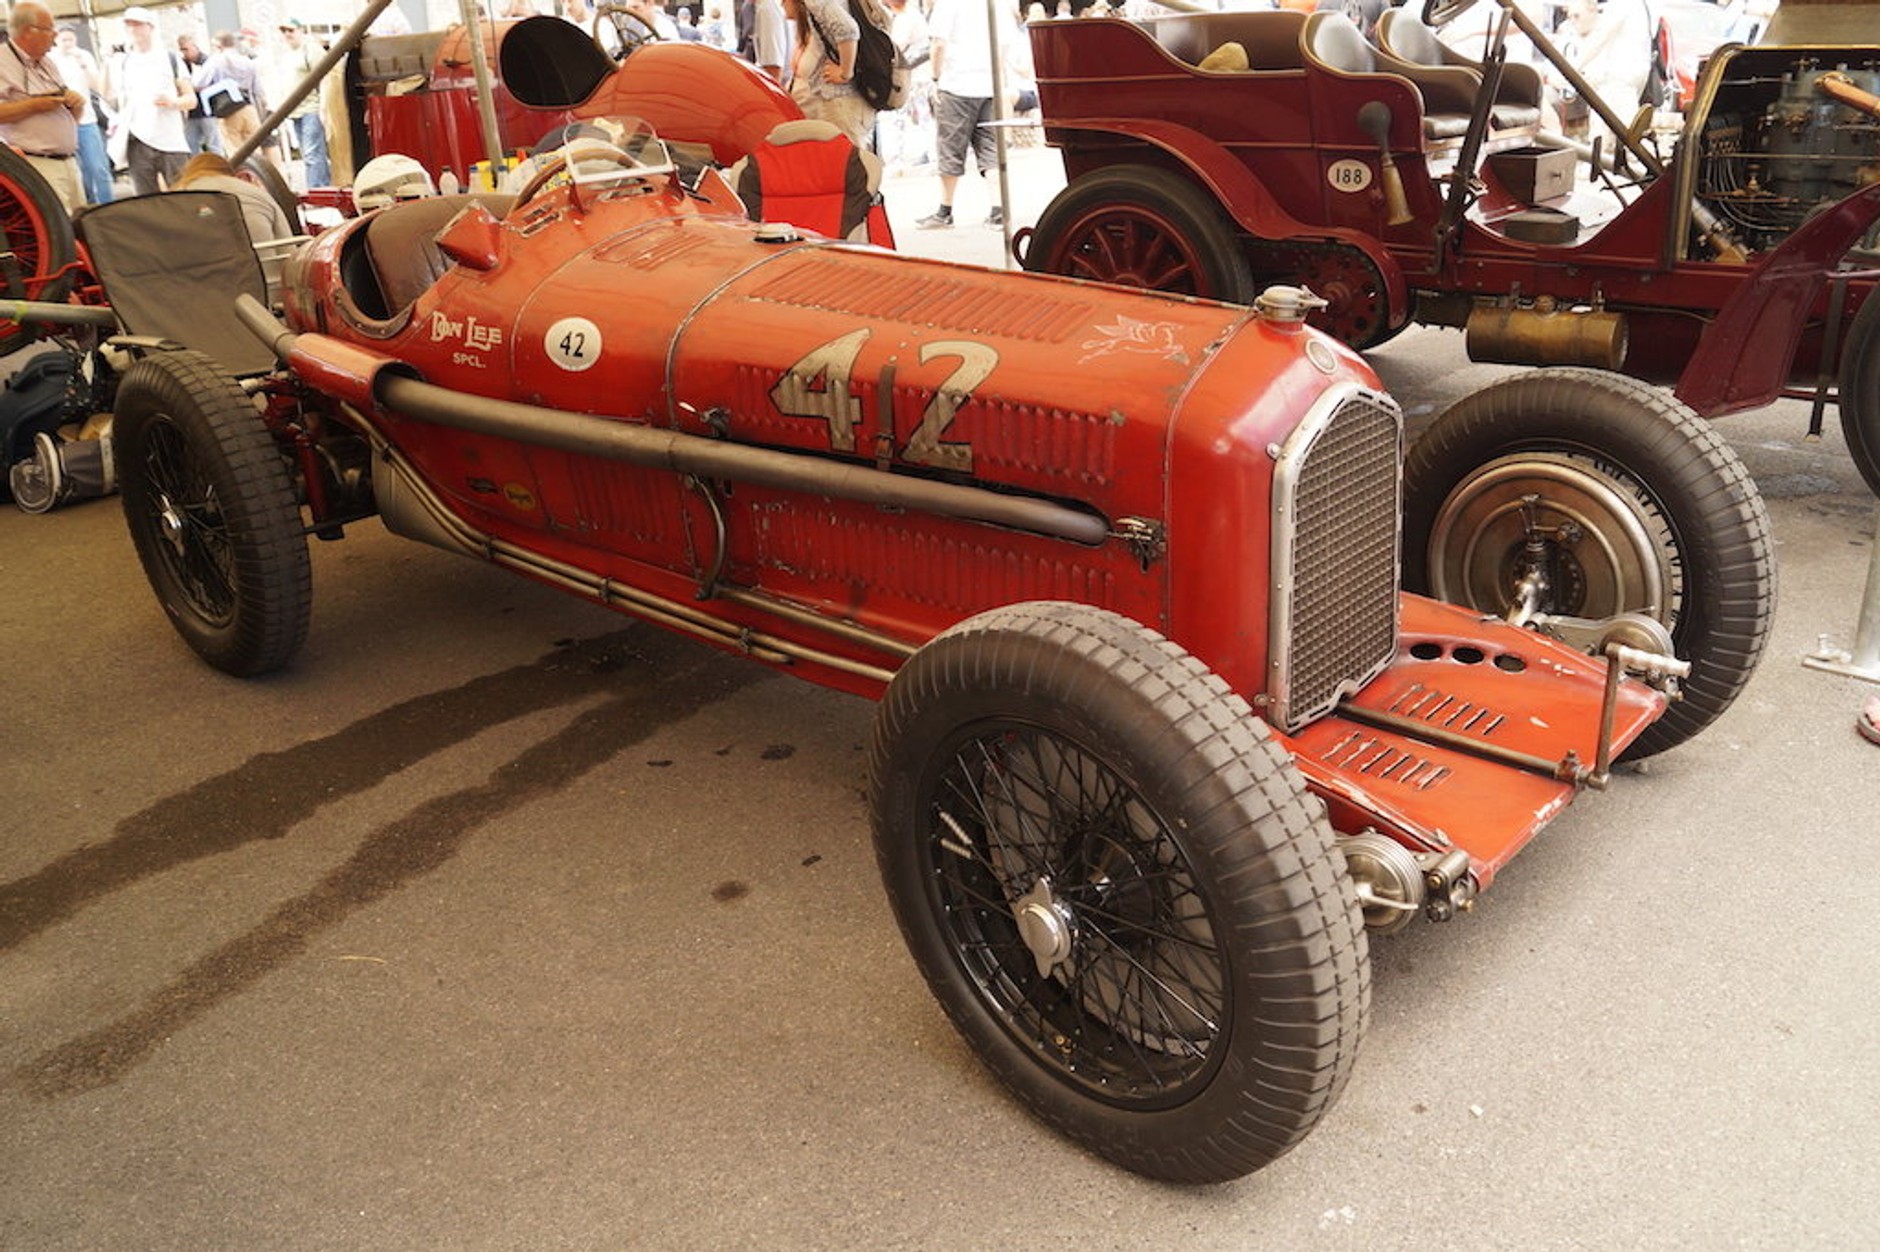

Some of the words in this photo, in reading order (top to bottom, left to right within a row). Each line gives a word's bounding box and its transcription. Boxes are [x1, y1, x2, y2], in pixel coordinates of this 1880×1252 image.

[1336, 168, 1362, 185] 188
[559, 331, 586, 358] 42
[453, 352, 487, 369] SPCL.
[768, 327, 999, 474] 42
